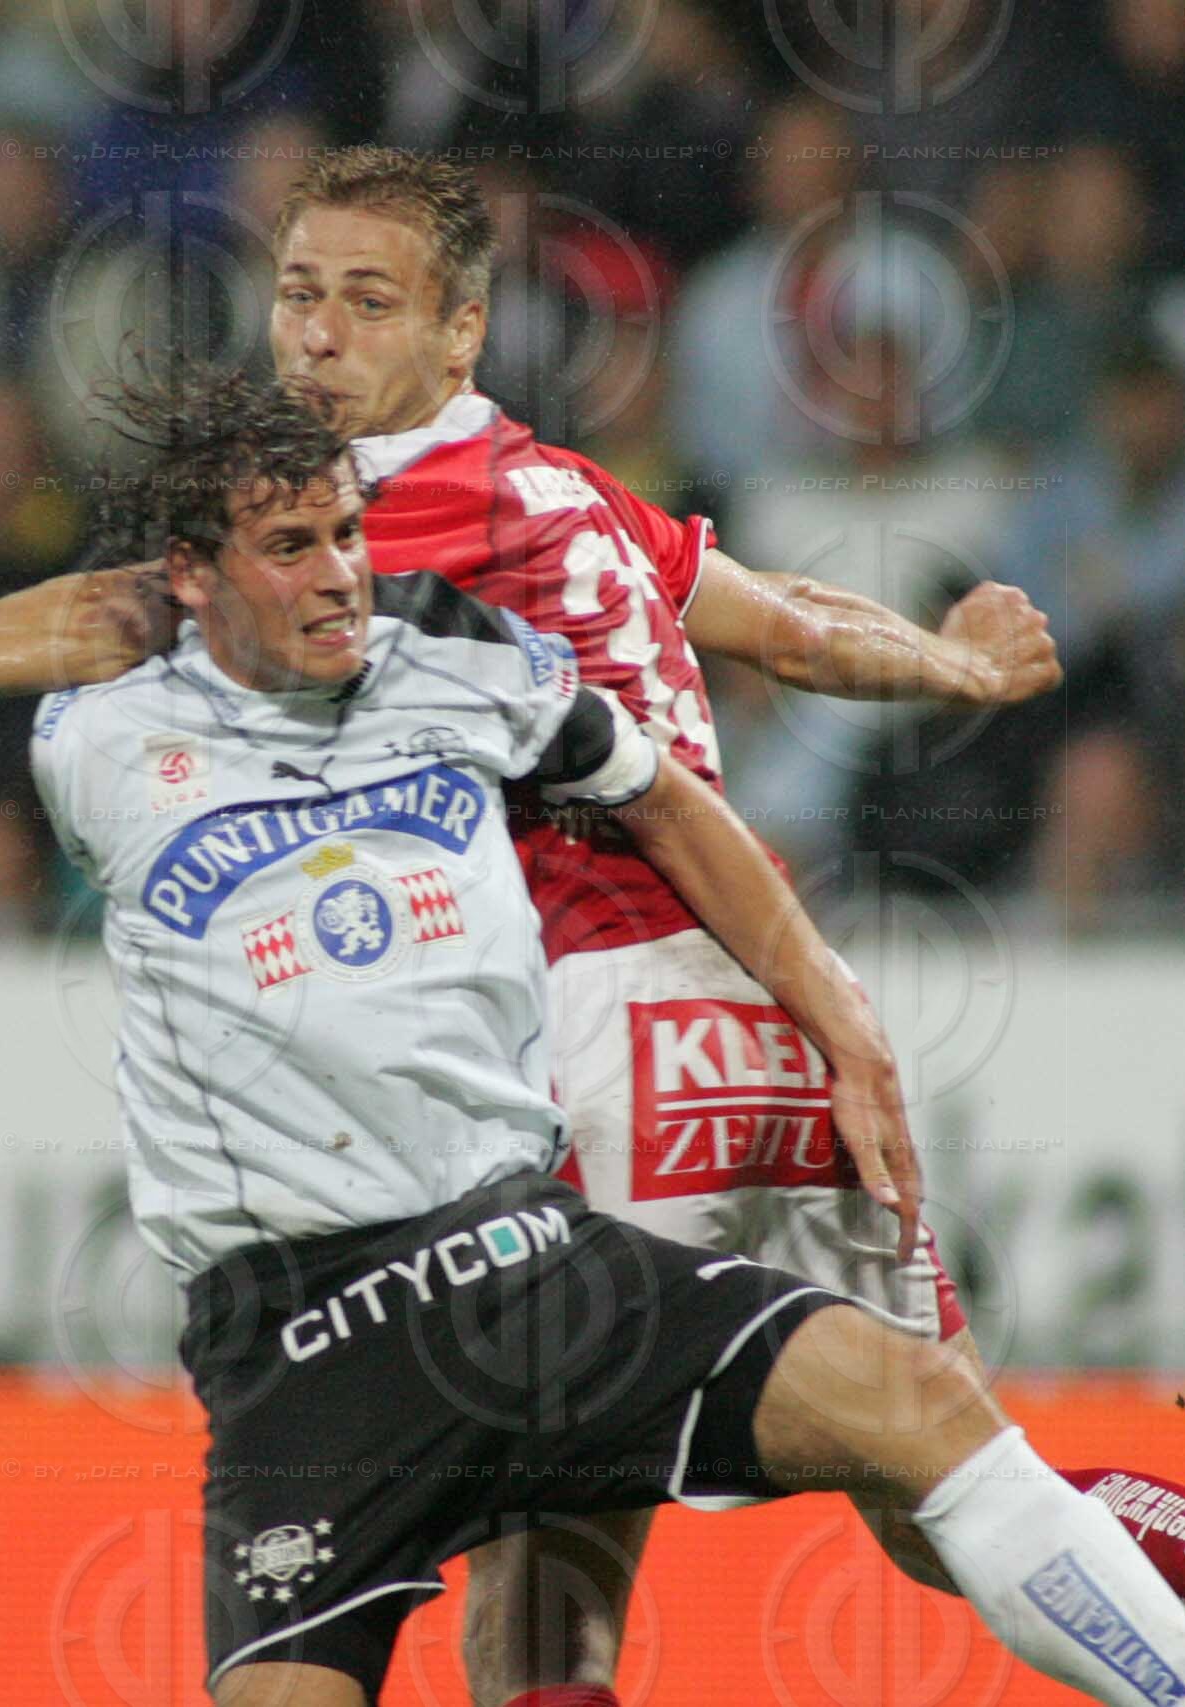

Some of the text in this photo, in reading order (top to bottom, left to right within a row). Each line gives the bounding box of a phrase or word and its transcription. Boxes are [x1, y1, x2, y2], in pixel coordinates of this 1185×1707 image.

[149, 767, 482, 926] PUNTIGAMER
[652, 1017, 827, 1093] KLEI
[654, 1114, 835, 1175] ZEITU
[280, 1206, 572, 1363] CITYCOM
